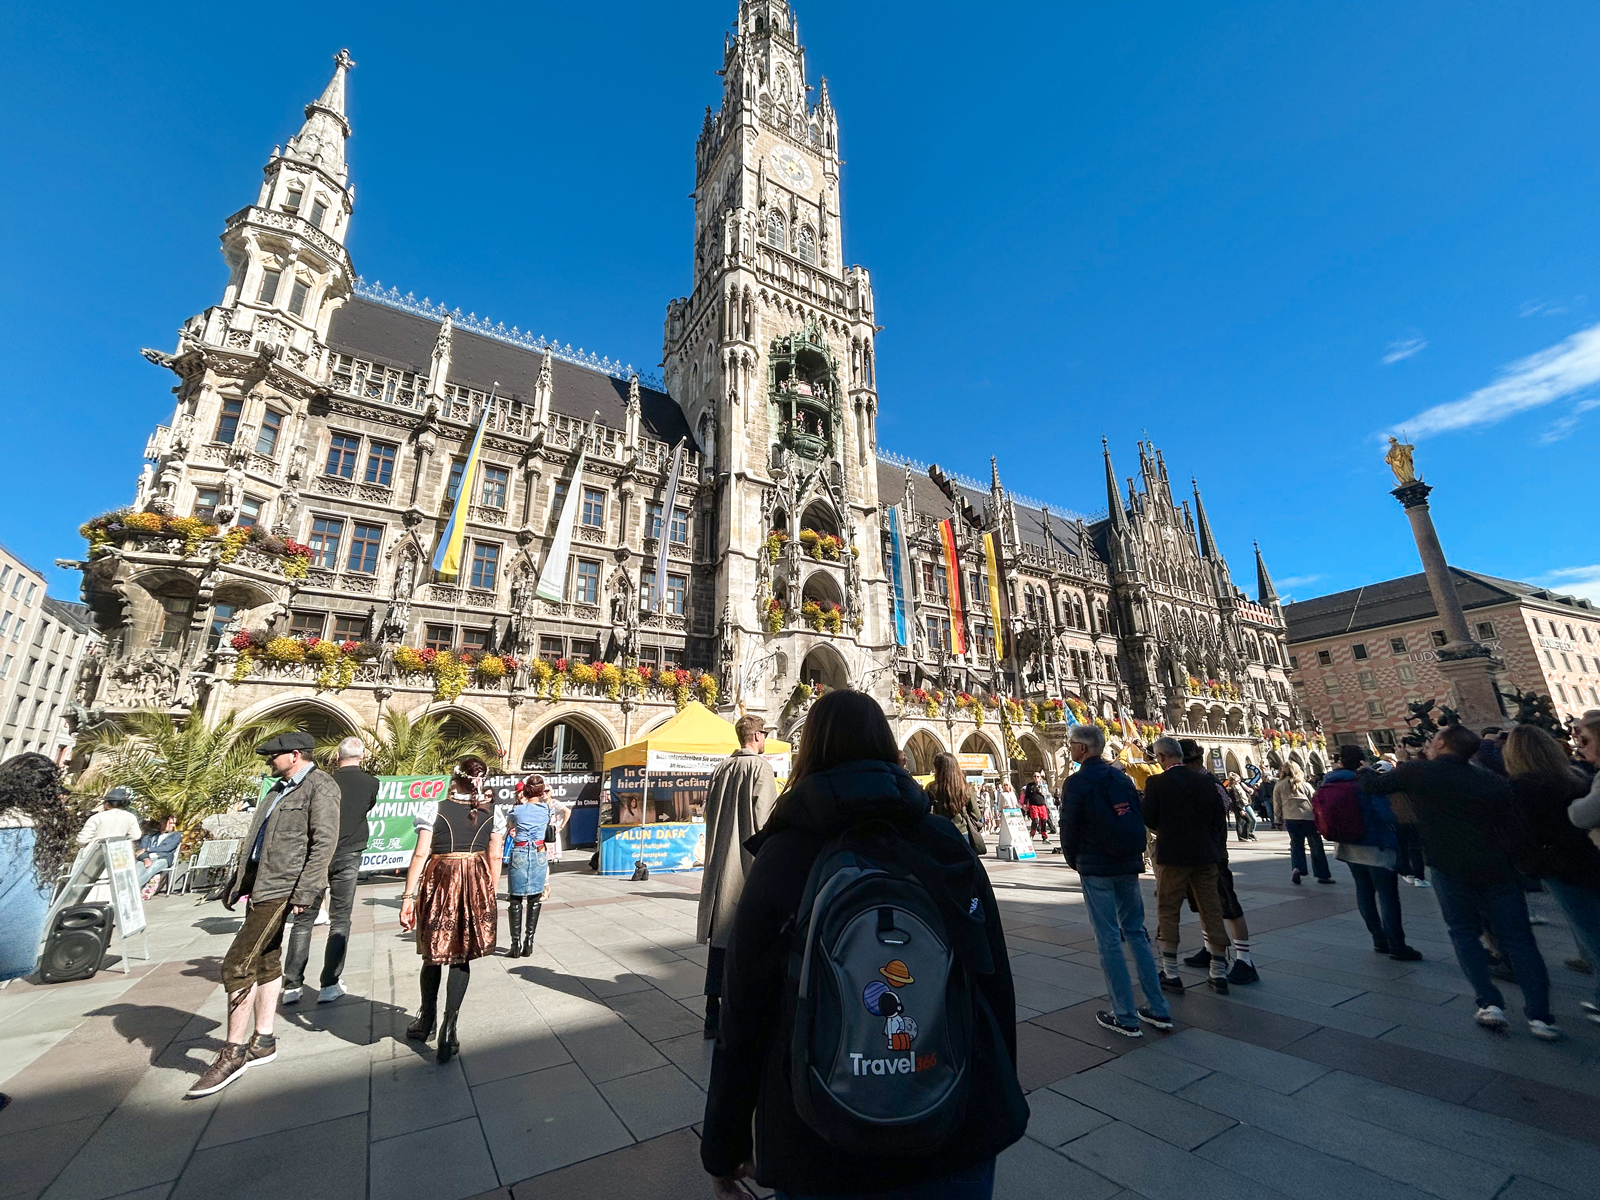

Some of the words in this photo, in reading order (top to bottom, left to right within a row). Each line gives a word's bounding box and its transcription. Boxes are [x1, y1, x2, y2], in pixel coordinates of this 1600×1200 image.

[538, 747, 579, 761] Lda
[1212, 749, 1221, 758] S
[523, 762, 588, 770] HAARSHMUCK
[1214, 758, 1222, 768] U
[624, 768, 635, 777] In
[658, 778, 674, 788] ins
[676, 777, 710, 789] Gefäng
[378, 781, 405, 800] VIL
[409, 780, 444, 800] CCP
[366, 802, 424, 818] MMUN
[615, 829, 651, 840] FALUN
[656, 828, 685, 839] DAFA
